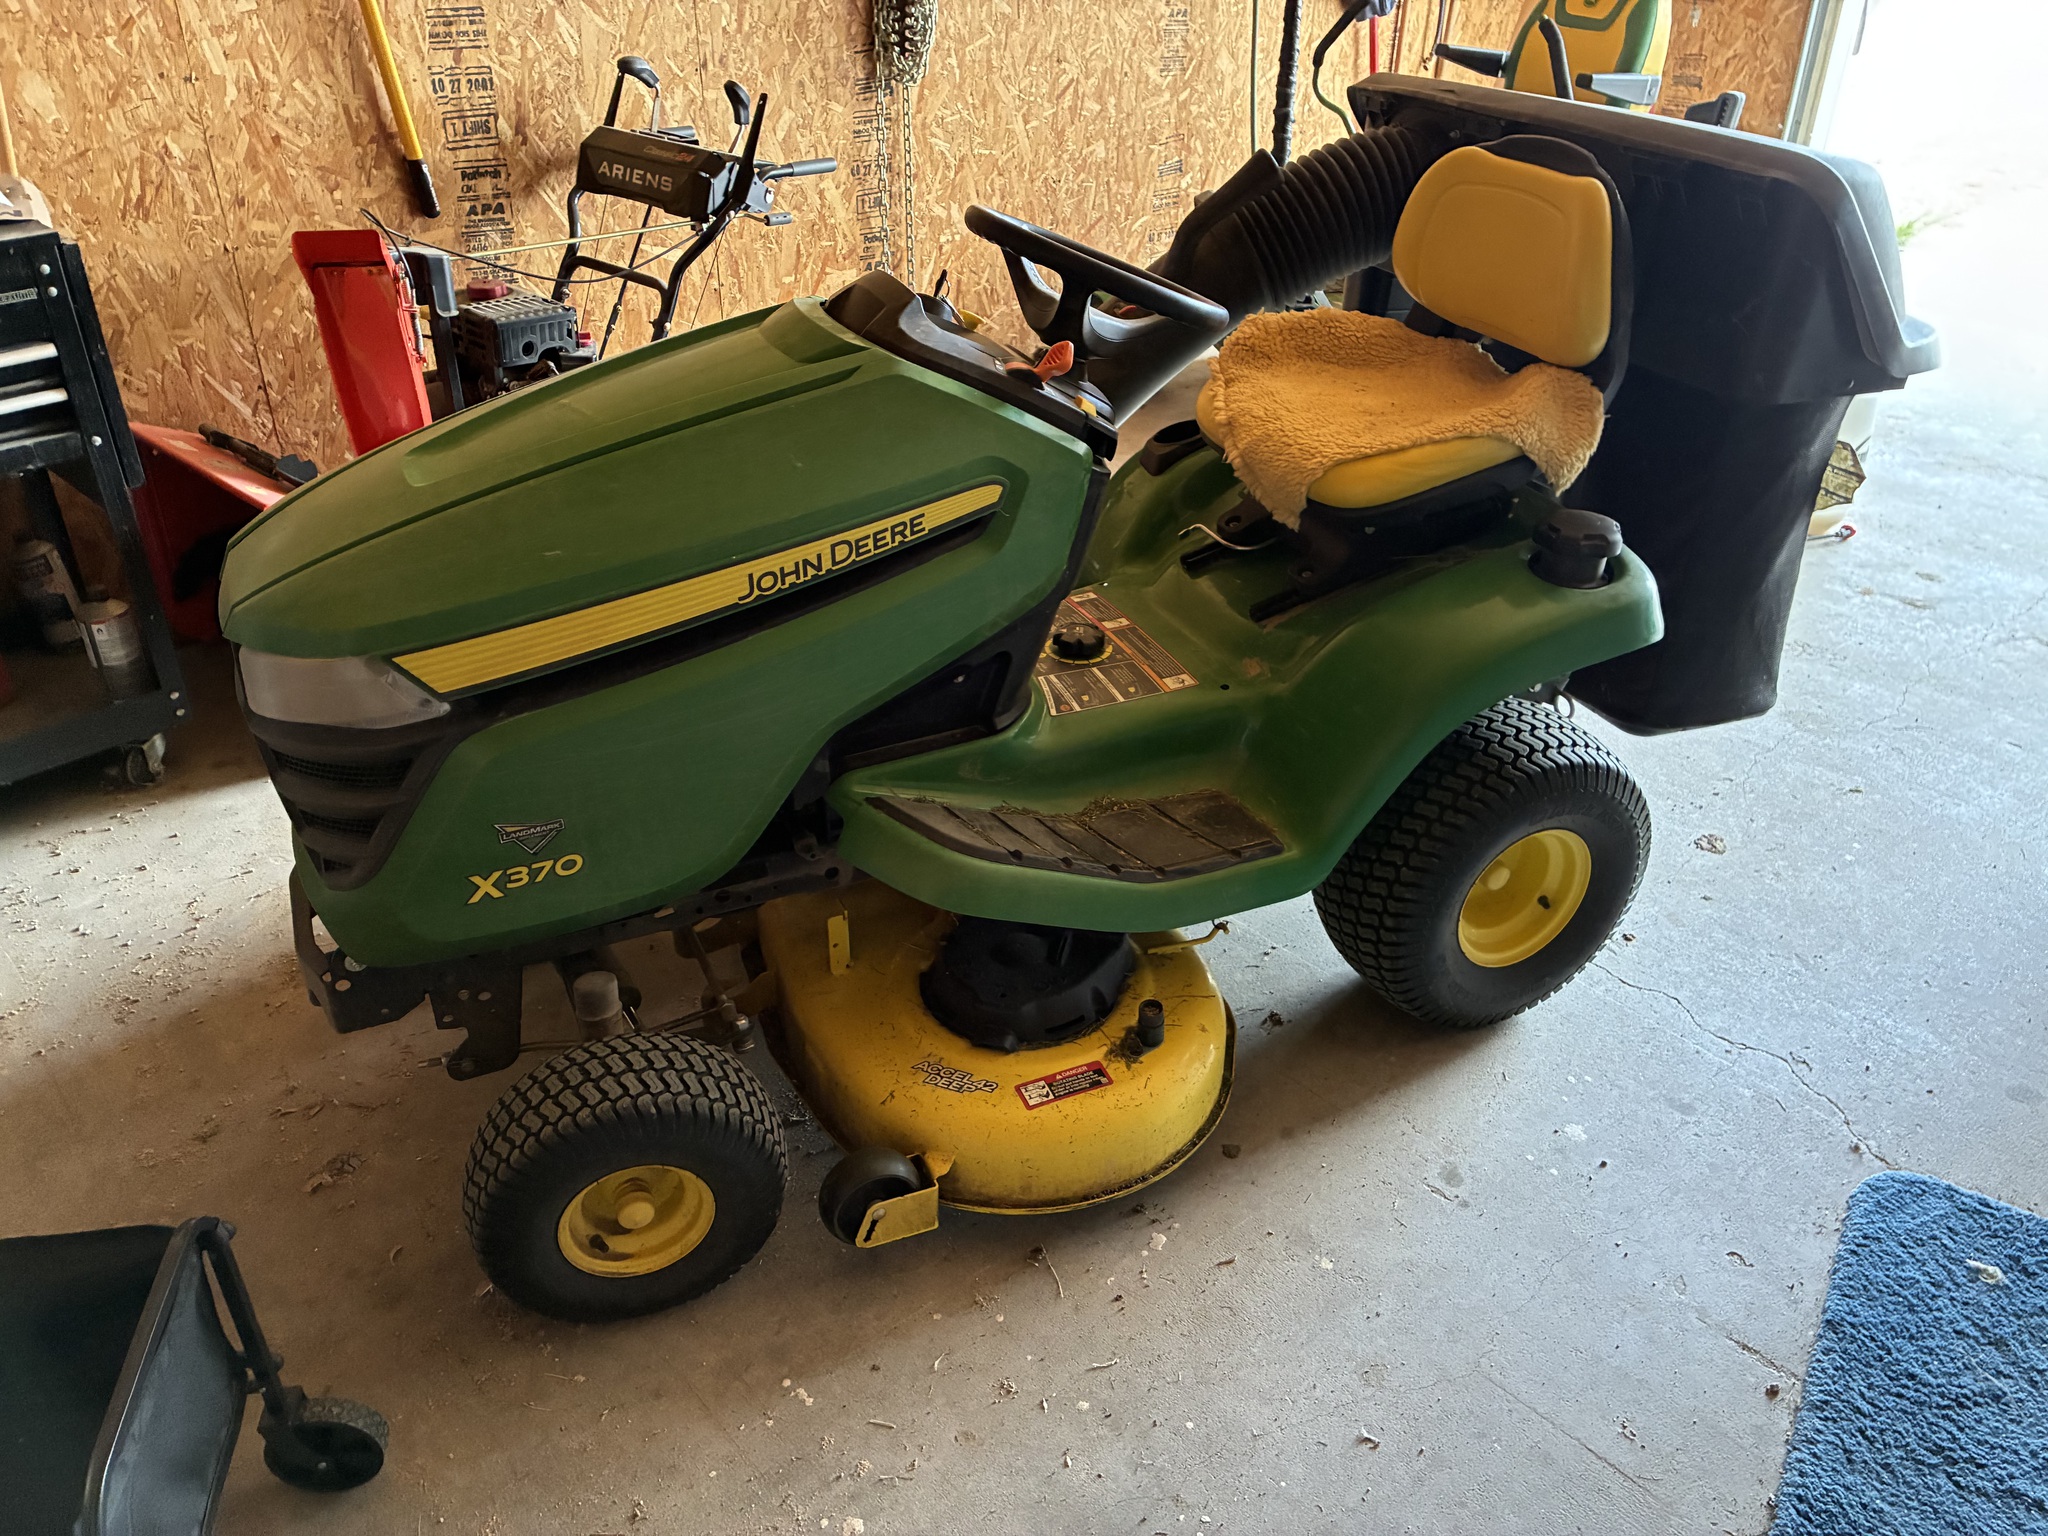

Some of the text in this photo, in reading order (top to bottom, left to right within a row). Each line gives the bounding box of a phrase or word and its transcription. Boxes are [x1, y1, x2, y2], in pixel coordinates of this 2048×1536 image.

[449, 78, 461, 94] 27
[463, 119, 491, 136] SHIFT
[598, 161, 672, 192] ARIENS
[466, 202, 506, 216] APA
[738, 512, 926, 602] JOHN DEERE
[503, 822, 561, 840] LANDMARK
[466, 853, 584, 904] X370
[912, 1060, 998, 1094] ACCEL 42
[1061, 1066, 1088, 1077] DANGER
[923, 1074, 977, 1094] DEEP
